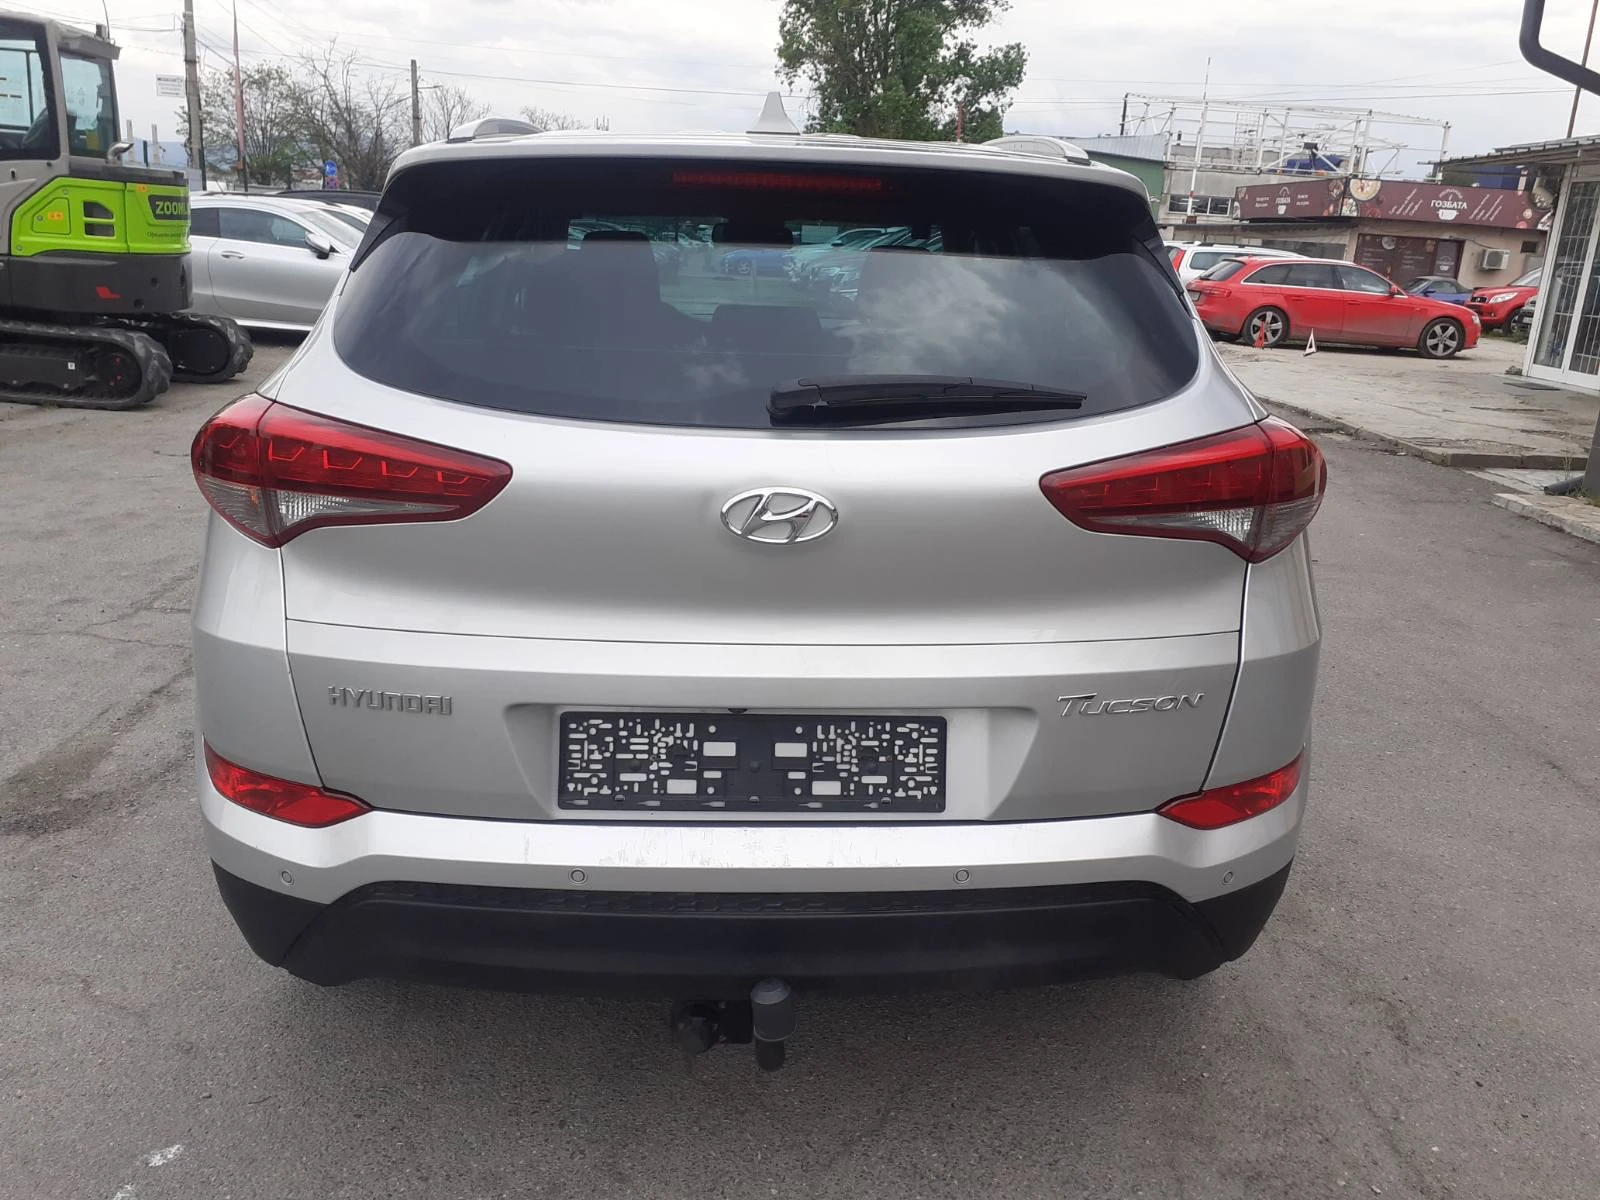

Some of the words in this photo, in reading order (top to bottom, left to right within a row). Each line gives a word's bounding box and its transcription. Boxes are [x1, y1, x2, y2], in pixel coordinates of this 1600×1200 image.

[1430, 199, 1468, 210] ГОЗБАТА
[327, 684, 453, 716] HYUNDAI
[1057, 692, 1206, 718] TUCSON
